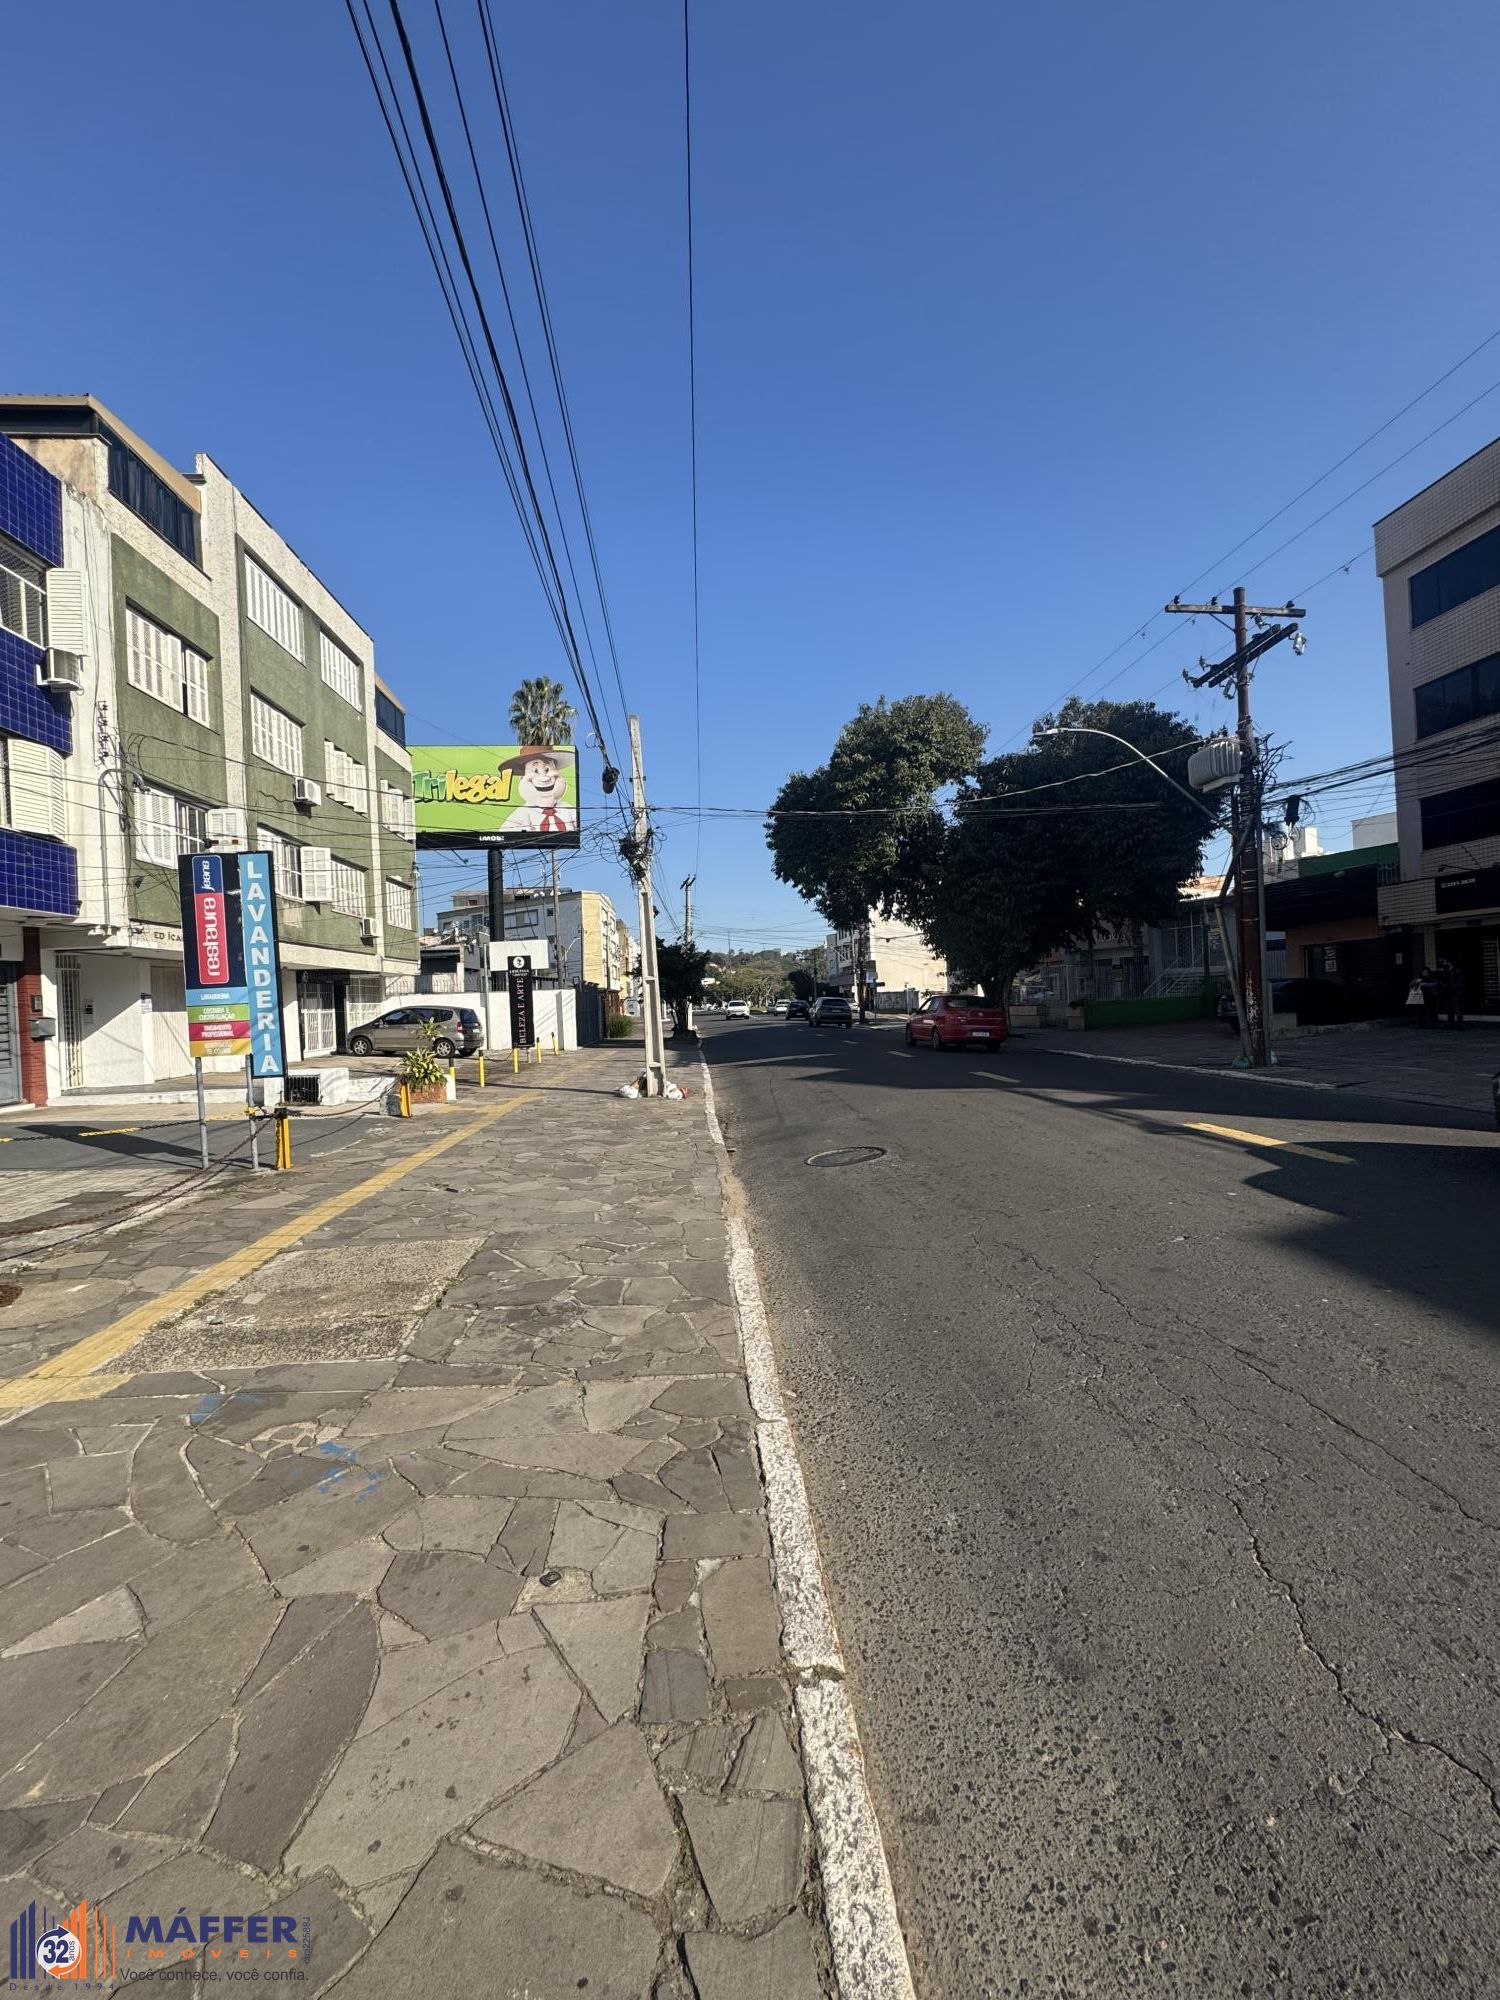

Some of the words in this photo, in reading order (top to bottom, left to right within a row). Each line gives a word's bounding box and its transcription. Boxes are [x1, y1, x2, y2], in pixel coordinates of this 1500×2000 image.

[201, 860, 216, 892] jeans
[203, 897, 221, 977] restaura
[246, 861, 280, 1073] LAVANDERIA
